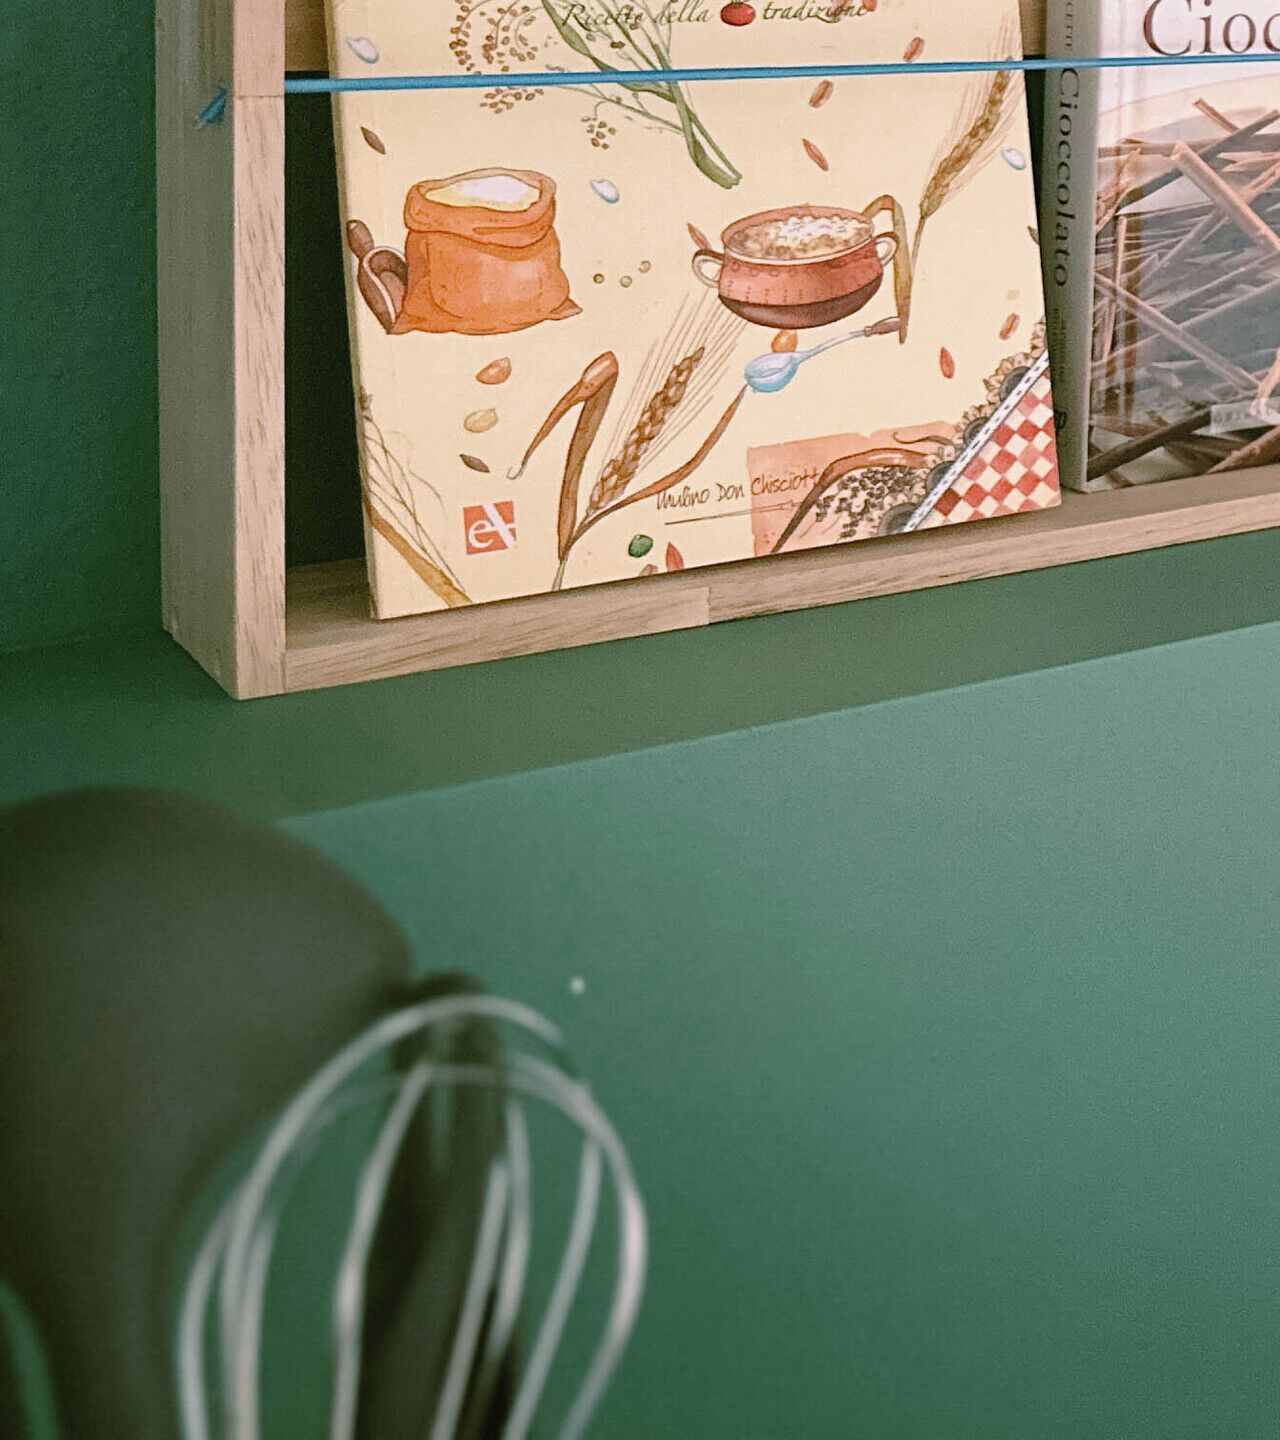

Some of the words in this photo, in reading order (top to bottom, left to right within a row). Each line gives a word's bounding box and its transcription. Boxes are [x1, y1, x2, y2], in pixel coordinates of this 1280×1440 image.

[1055, 67, 1080, 287] Cioccolato
[656, 484, 711, 511] Mulino
[716, 482, 746, 503] Don
[751, 466, 821, 497] Chisciott
